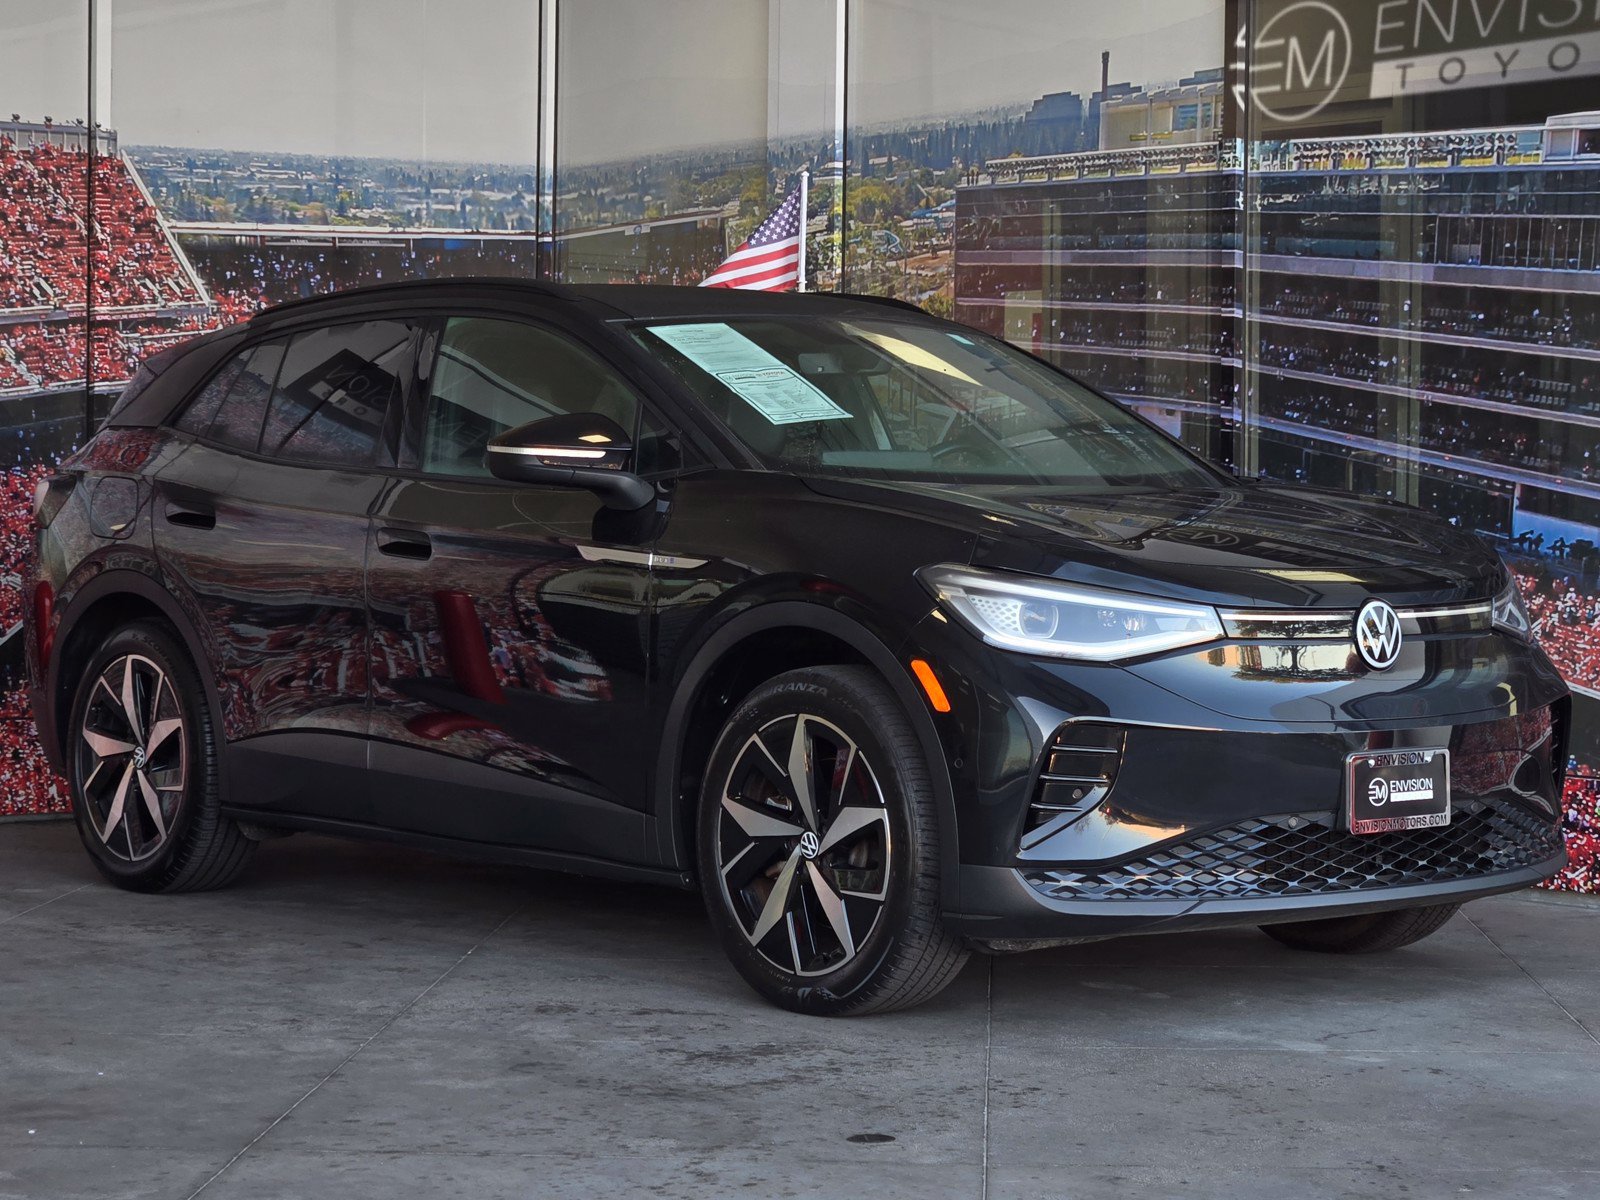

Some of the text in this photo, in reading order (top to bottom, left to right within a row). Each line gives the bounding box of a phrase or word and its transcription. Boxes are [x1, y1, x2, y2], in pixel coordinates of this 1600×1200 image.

[1395, 41, 1581, 90] TOYO
[1357, 601, 1402, 668] VW
[1376, 752, 1425, 766] ENVISION
[1390, 778, 1433, 792] ENVISION
[1355, 815, 1447, 833] ENVISIONMOTORS.COM
